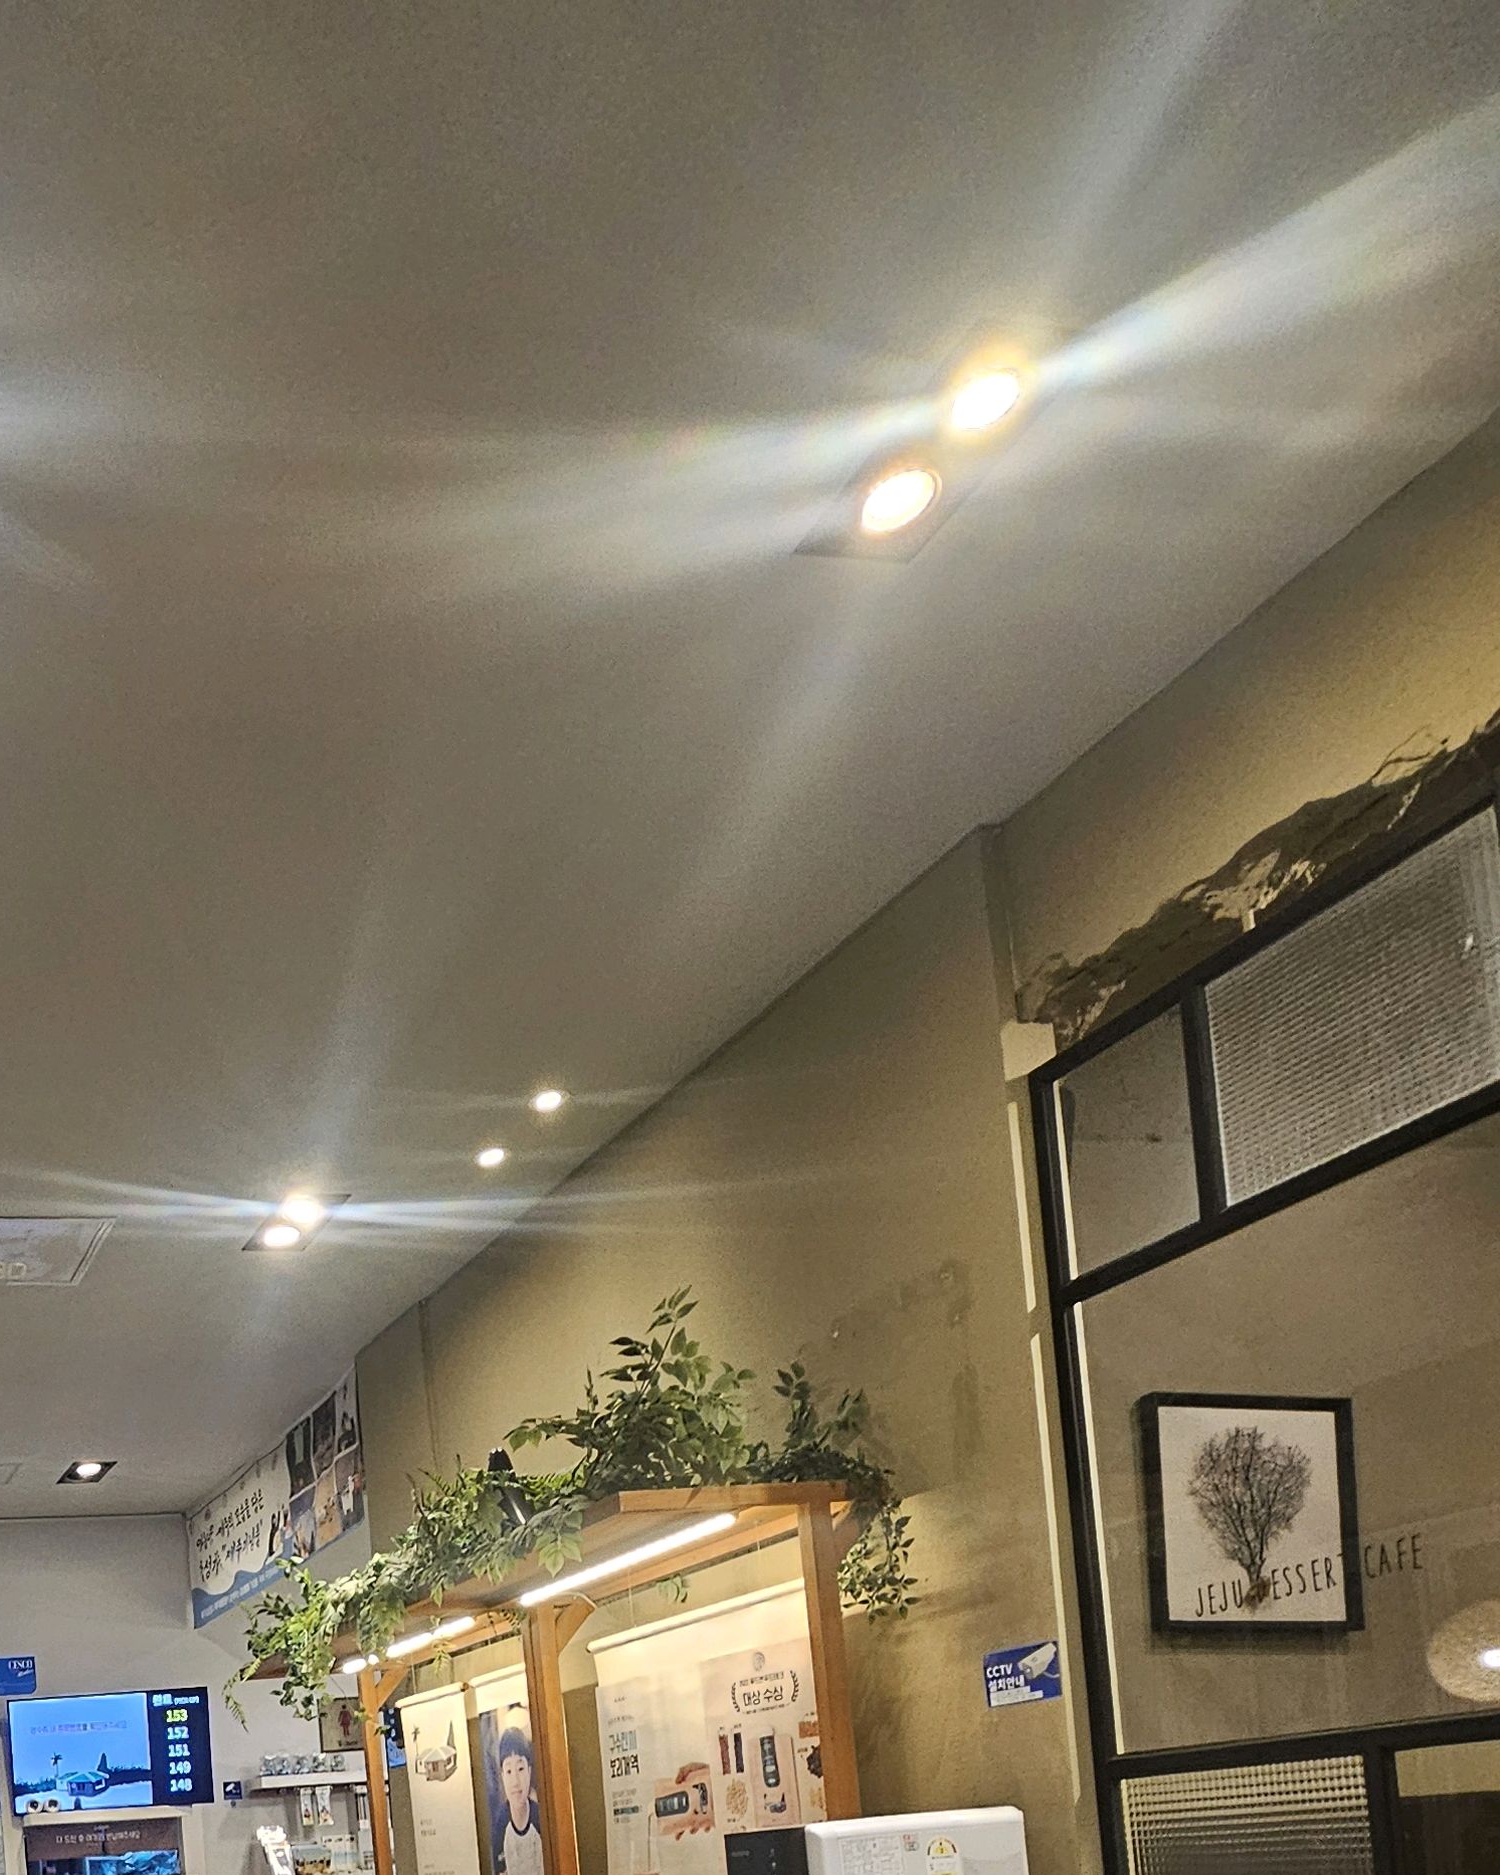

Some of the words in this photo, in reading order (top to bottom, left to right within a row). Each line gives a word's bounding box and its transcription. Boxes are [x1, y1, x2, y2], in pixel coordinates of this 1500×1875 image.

[1195, 1579, 1243, 1618] JEJU
[1257, 1552, 1344, 1602] ESSER
[1363, 1532, 1424, 1579] CAFE
[986, 1663, 1013, 1678] CCTV
[988, 1675, 1025, 1693] 설치안내
[743, 1690, 761, 1707] 대상
[763, 1686, 784, 1704] 수상
[167, 1709, 189, 1723] 153
[167, 1727, 189, 1739] 152
[168, 1744, 190, 1757] 151
[169, 1761, 191, 1775] 149
[610, 1754, 640, 1778] 보리개역
[170, 1778, 192, 1792] 148
